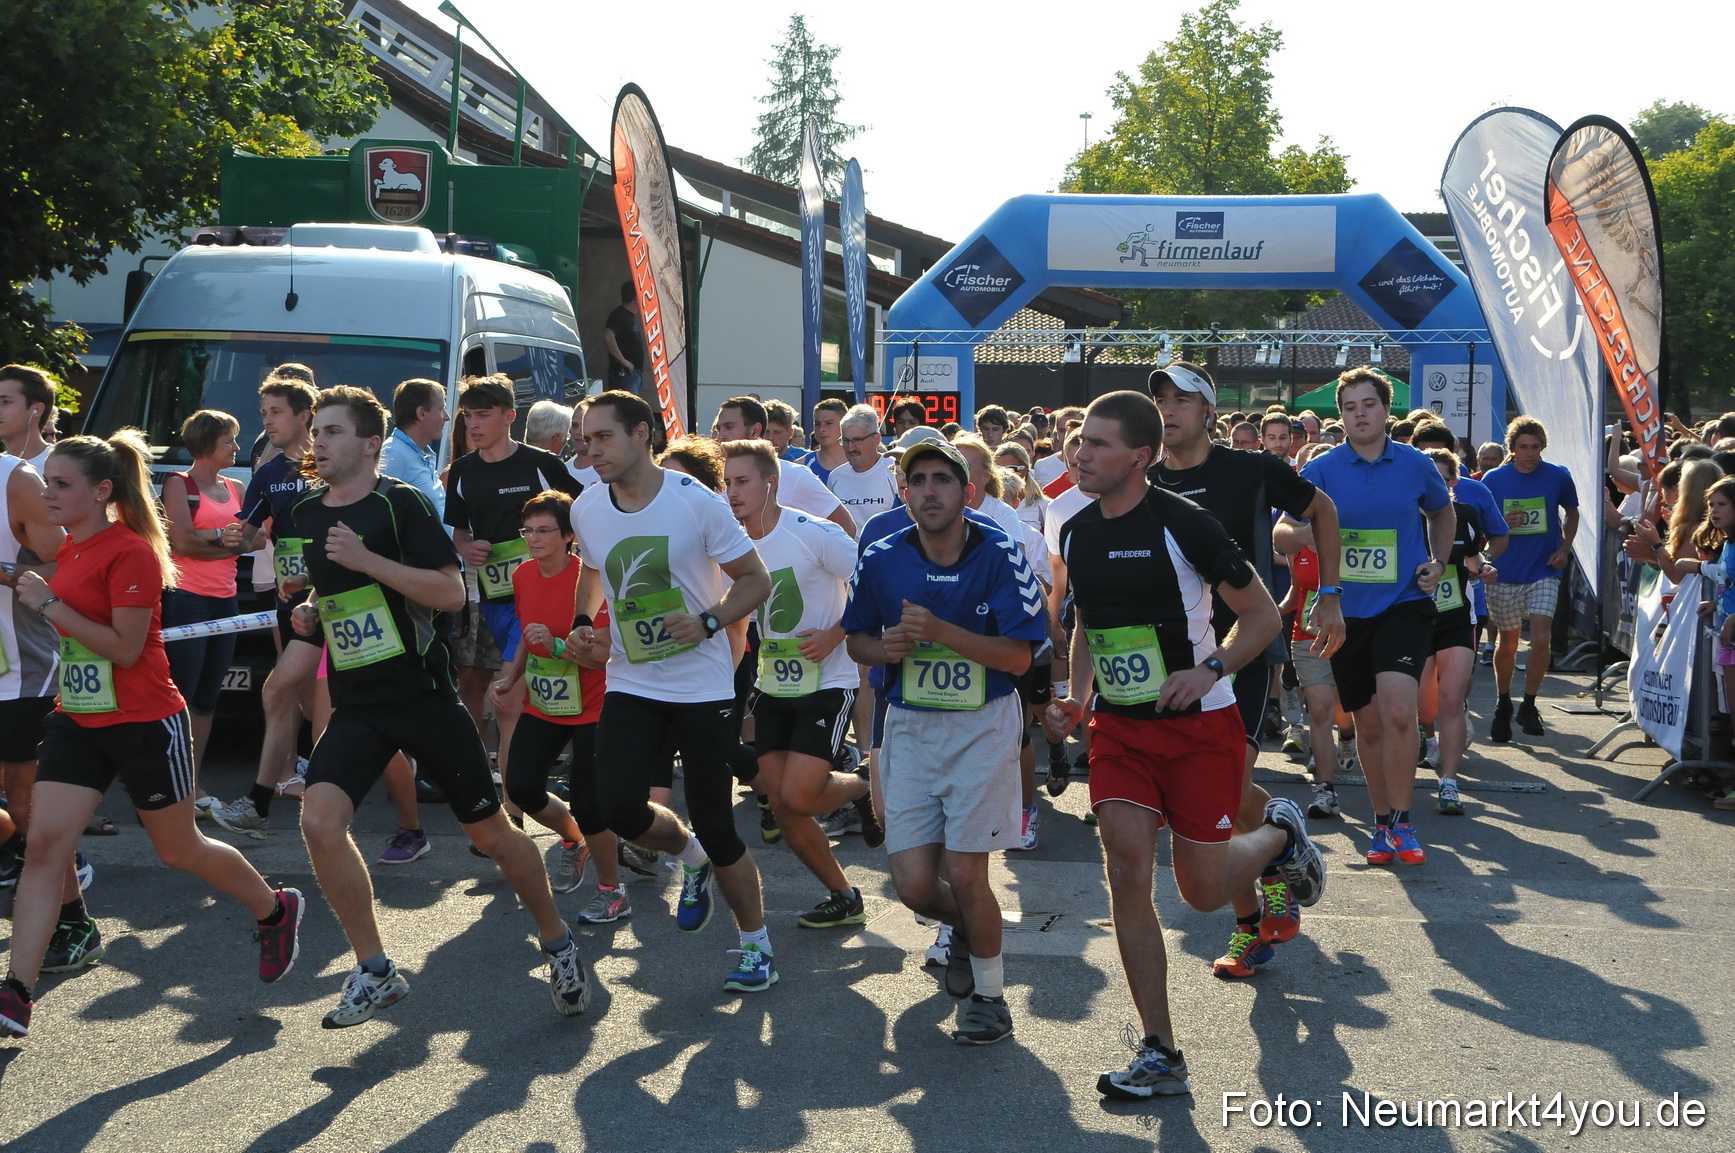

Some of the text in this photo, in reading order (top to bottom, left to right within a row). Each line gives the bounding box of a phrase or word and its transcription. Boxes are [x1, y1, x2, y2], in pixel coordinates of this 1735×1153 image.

[385, 205, 411, 217] 1628
[1185, 221, 1221, 230] Fischer
[1158, 240, 1265, 260] firmenlauf
[955, 274, 1012, 286] Fischer
[1378, 277, 1394, 287] und
[1396, 275, 1411, 283] das
[270, 482, 295, 493] EURO
[840, 497, 884, 505] DELPHI
[1114, 550, 1151, 558] PFLEIDERER
[1345, 547, 1387, 569] 678
[926, 573, 959, 582] hummel
[331, 612, 384, 650] 594
[63, 664, 101, 693] 498
[774, 659, 803, 682] 99
[913, 660, 971, 691] 708
[1099, 653, 1150, 686] 969
[222, 670, 249, 688] 72
[531, 676, 570, 700] 492
